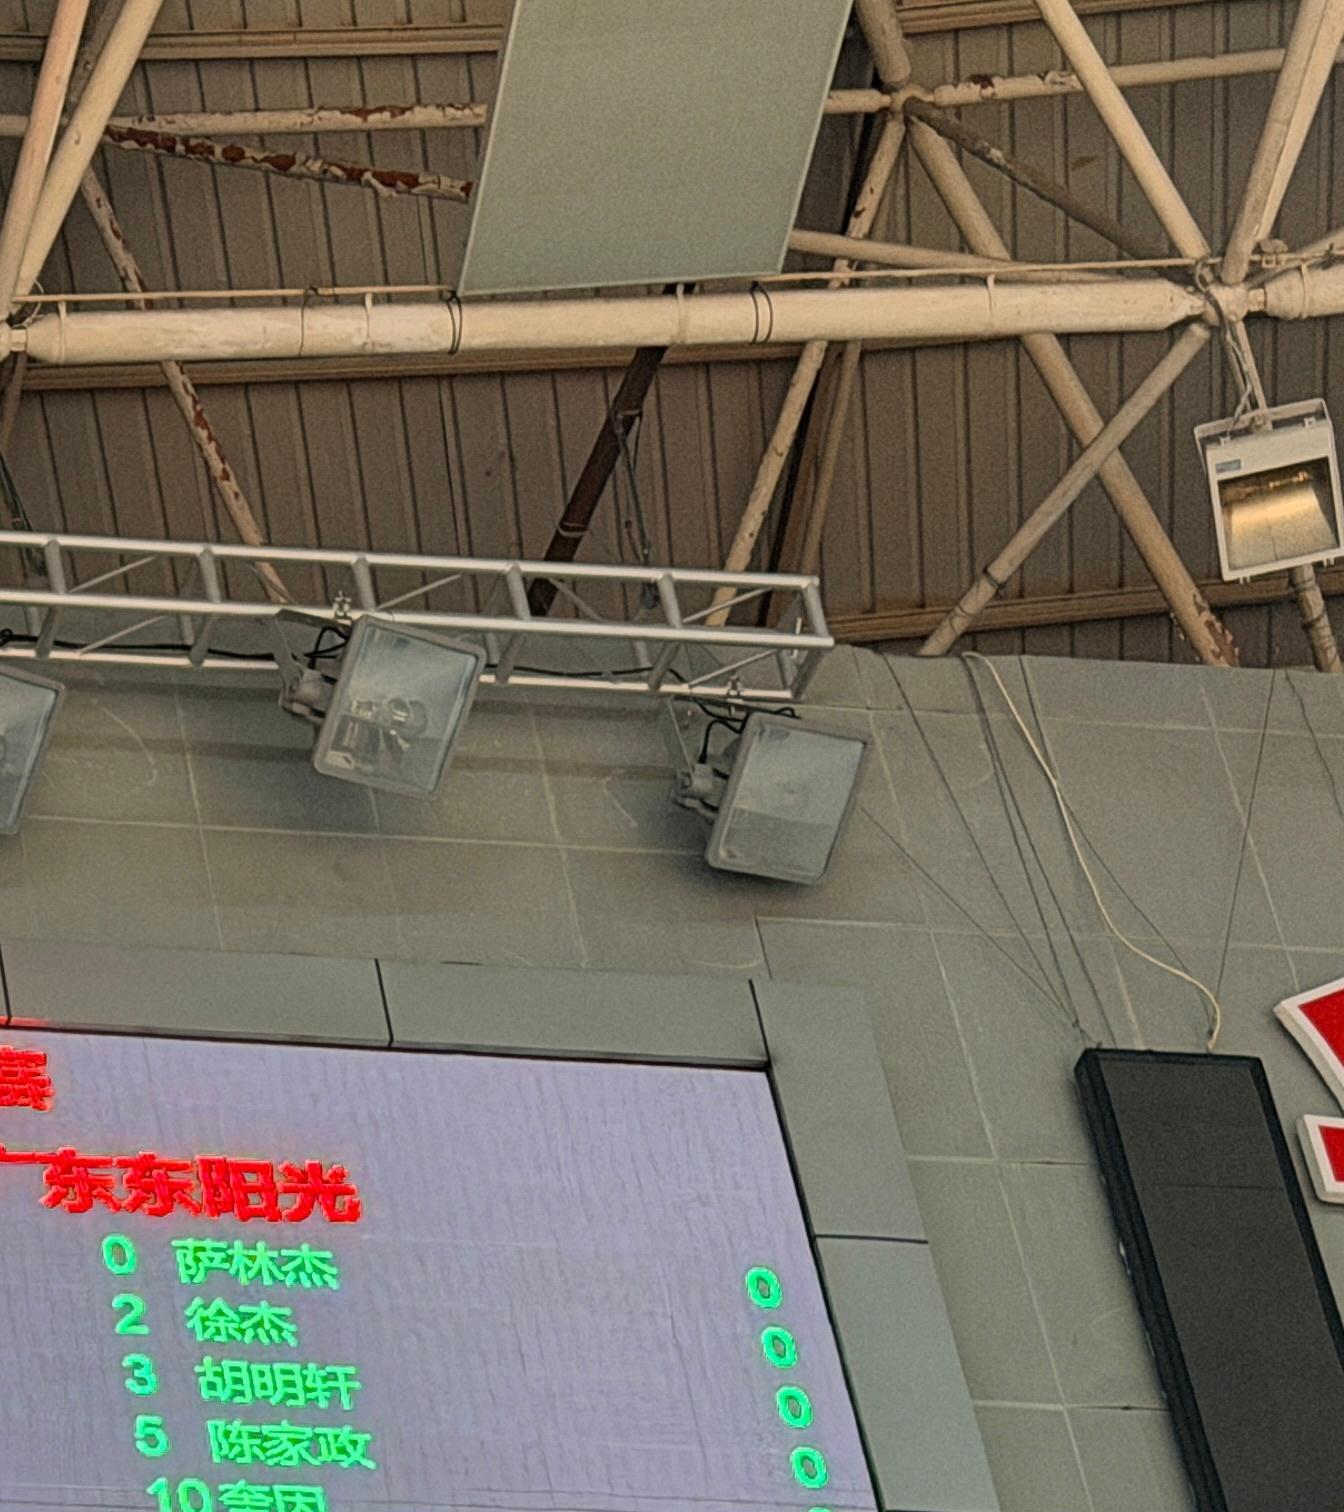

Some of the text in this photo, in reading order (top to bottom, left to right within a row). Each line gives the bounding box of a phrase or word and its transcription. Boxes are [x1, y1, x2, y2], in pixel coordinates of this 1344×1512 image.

[101, 1233, 341, 1291] 0 萨林杰
[745, 1266, 784, 1311] 0
[111, 1292, 301, 1349] 2 徐杰
[759, 1324, 800, 1371] 0
[121, 1352, 363, 1411] 3 胡明轩
[775, 1385, 815, 1430] 0
[133, 1412, 172, 1460] 5
[789, 1444, 830, 1491] 0
